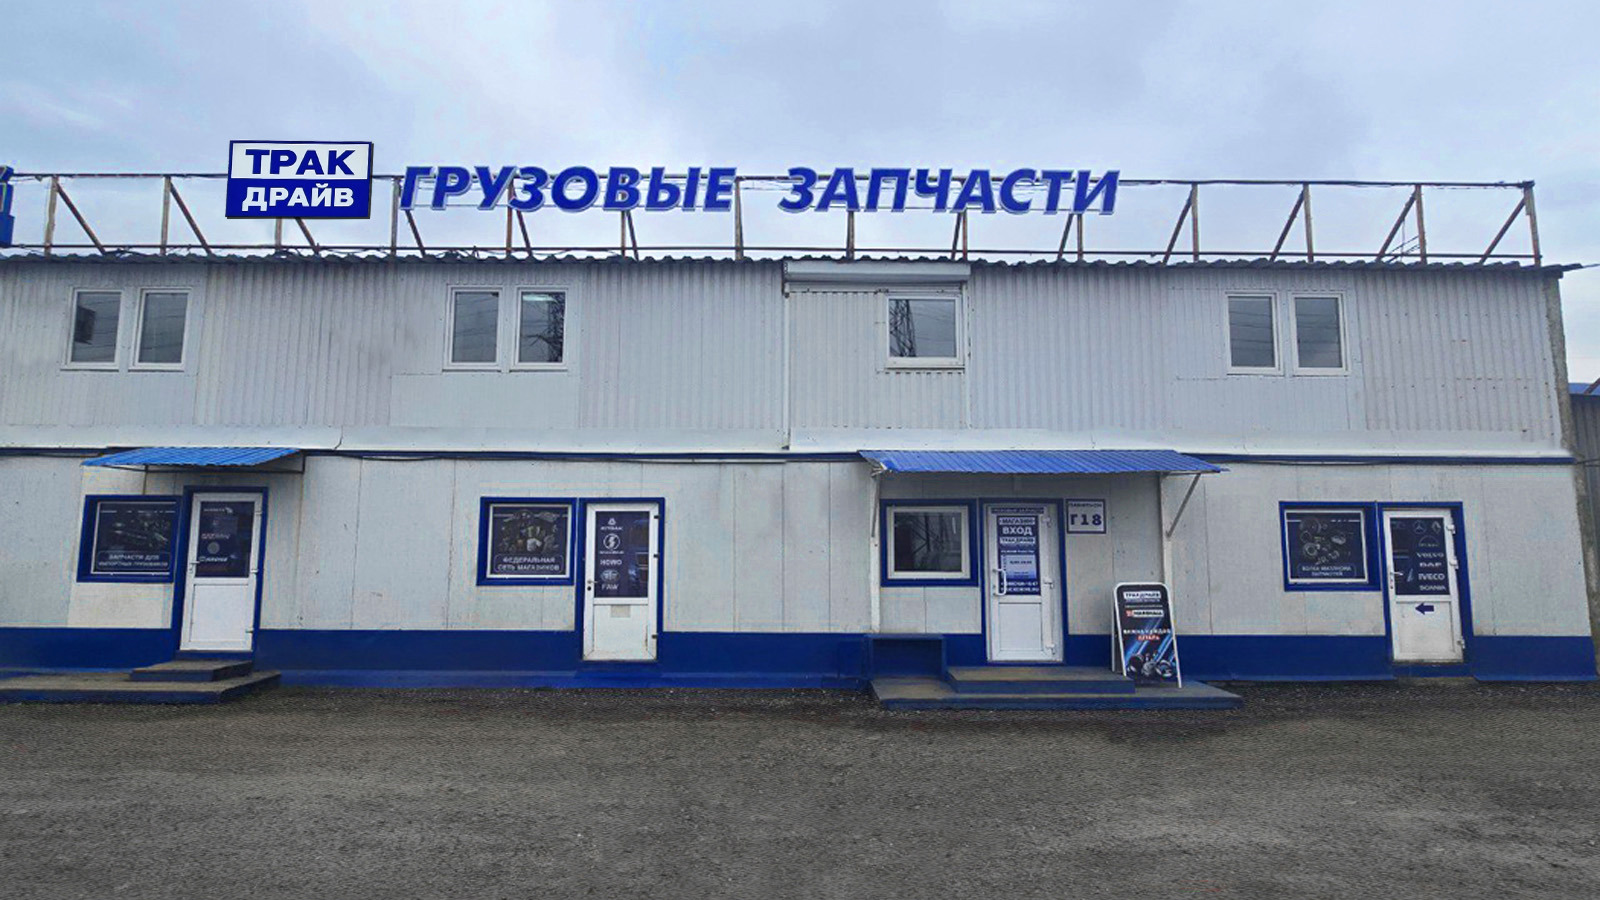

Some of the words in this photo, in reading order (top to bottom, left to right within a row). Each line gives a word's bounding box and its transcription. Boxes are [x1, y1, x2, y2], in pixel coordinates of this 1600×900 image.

[245, 148, 356, 176] ТРАК
[241, 183, 354, 212] ДРАЙВ
[400, 166, 738, 213] ГРУЗОВЫЕ
[777, 166, 1121, 215] ЗАПЧАСТИ
[1002, 526, 1033, 536] ВХОД
[1070, 513, 1102, 526] Г18
